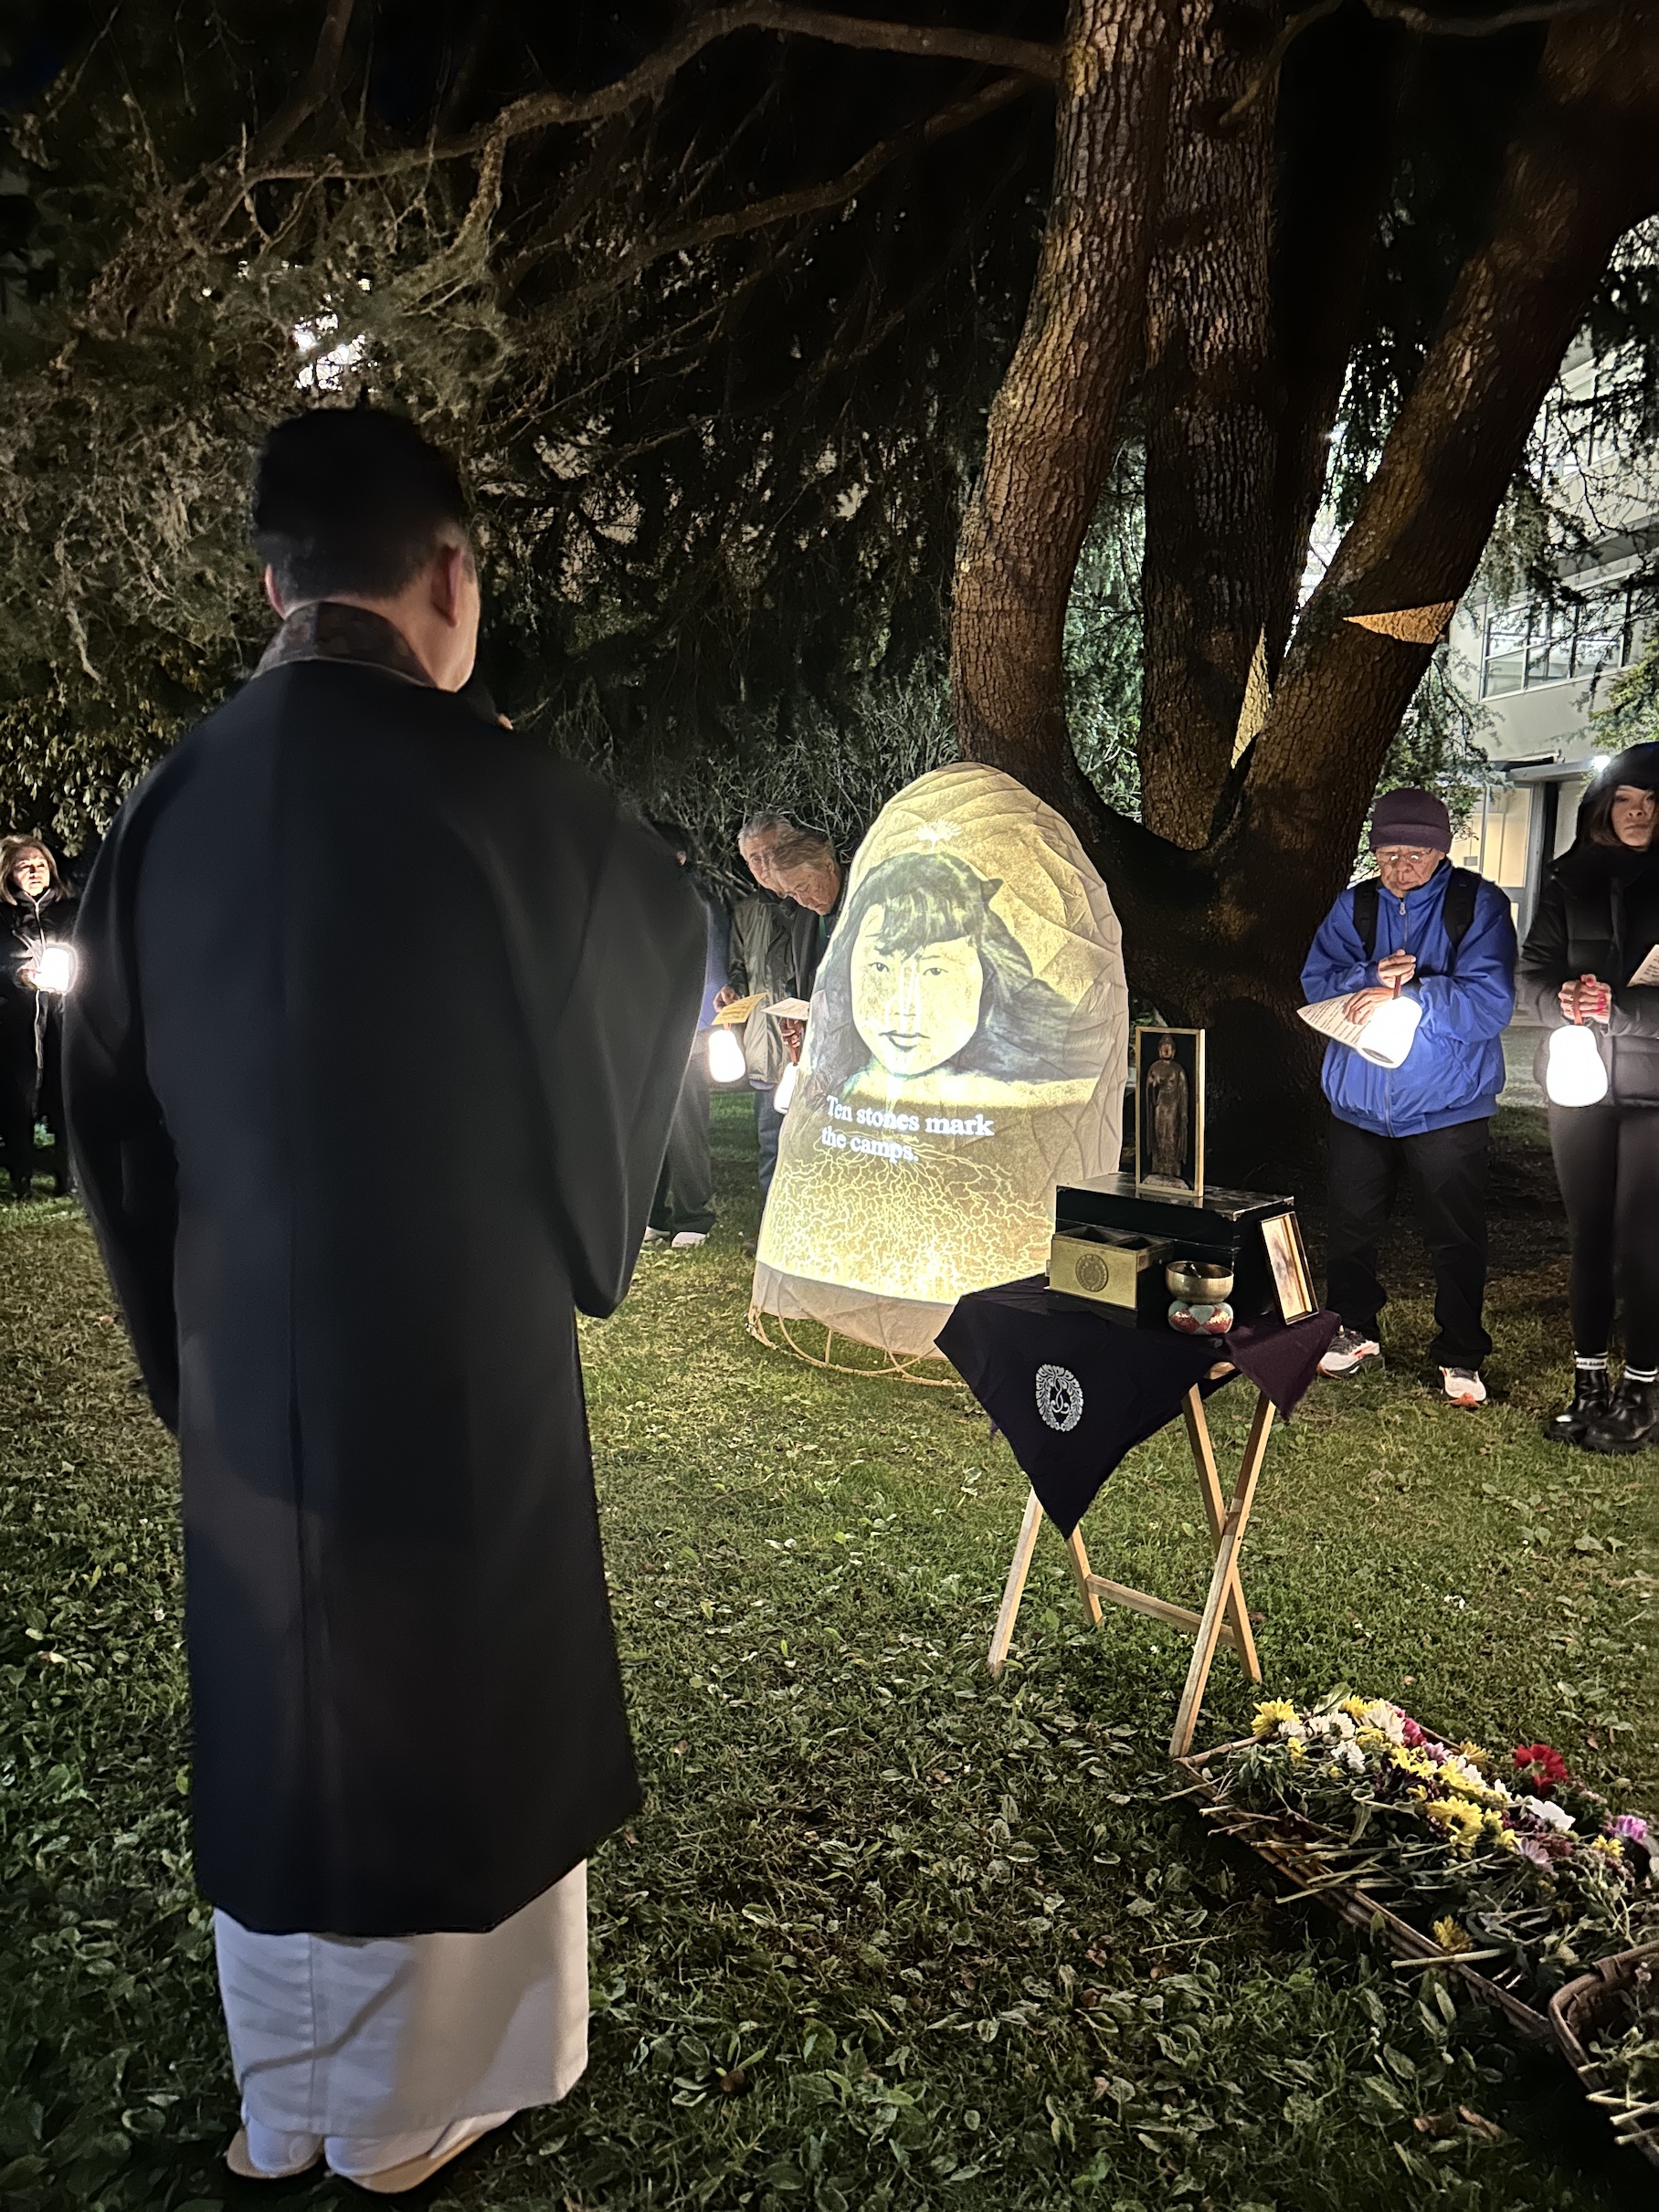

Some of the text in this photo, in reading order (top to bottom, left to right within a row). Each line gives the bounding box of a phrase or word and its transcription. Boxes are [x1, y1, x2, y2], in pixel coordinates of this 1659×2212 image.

[827, 1095, 995, 1136] Ten stones mark
[822, 1125, 919, 1164] the camps.
